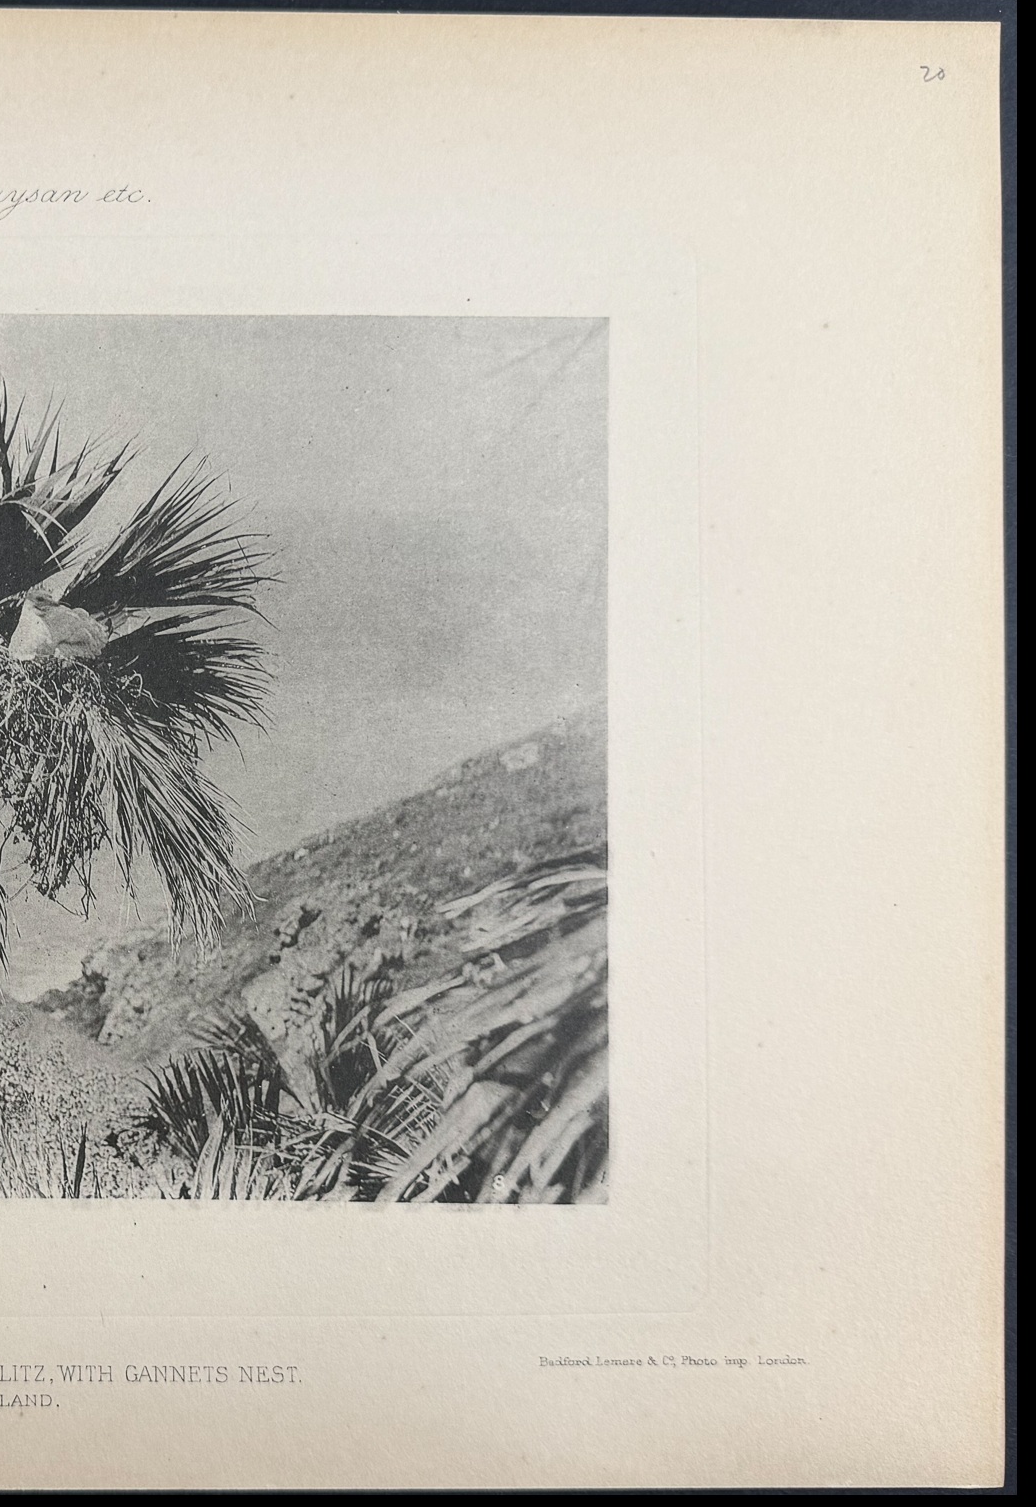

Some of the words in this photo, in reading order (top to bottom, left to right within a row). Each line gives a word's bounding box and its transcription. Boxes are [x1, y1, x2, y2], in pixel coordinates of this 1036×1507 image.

[920, 65, 946, 82] 20
[97, 184, 152, 204] etc.
[493, 1174, 505, 1190] 8
[539, 1355, 592, 1367] Bedford
[595, 1356, 643, 1367] Lemere
[647, 1355, 658, 1366] &
[681, 1355, 718, 1366] Photo
[124, 1364, 230, 1383] GANNETS
[238, 1365, 304, 1384] NEST.
